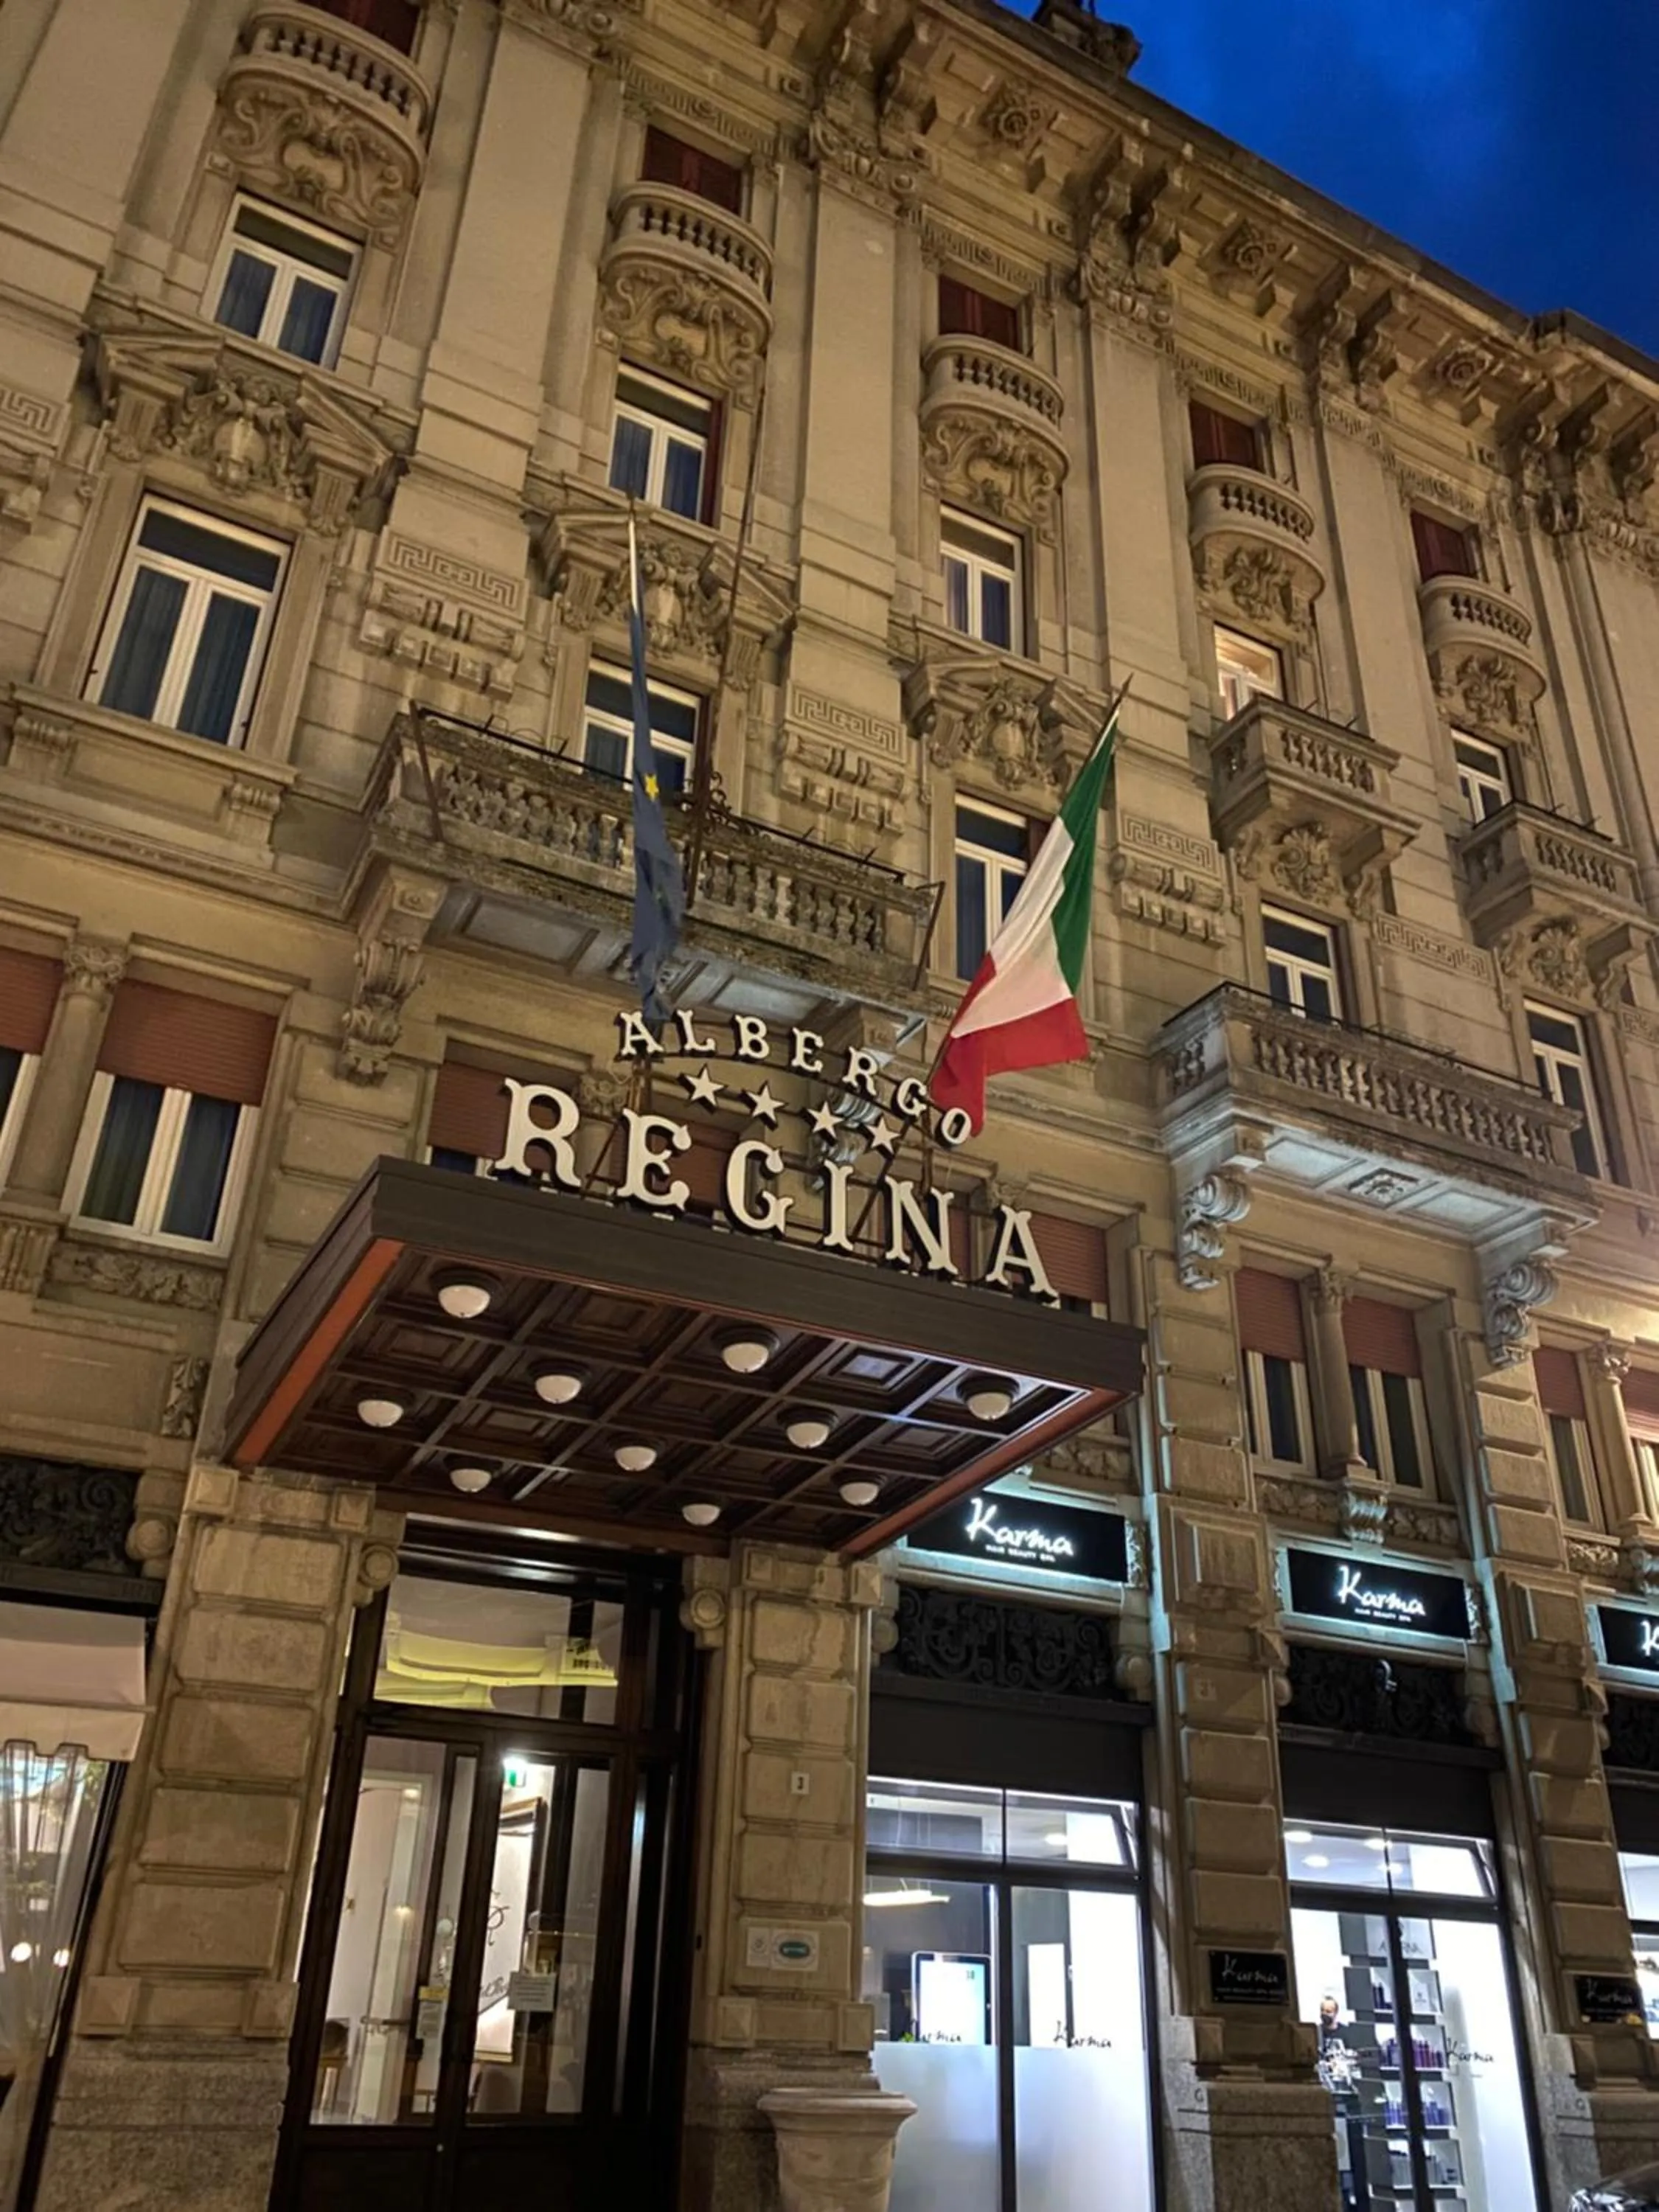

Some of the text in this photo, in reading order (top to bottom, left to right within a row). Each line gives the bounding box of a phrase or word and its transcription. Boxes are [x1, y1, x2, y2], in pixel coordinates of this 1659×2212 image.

[618, 1009, 973, 1147] ALBERGO
[495, 1077, 1059, 1301] REGINA
[965, 1498, 1074, 1557] Karma
[1338, 1565, 1426, 1616] Karma
[1222, 1953, 1279, 1983] Karma
[1446, 2037, 1494, 2063] Karma
